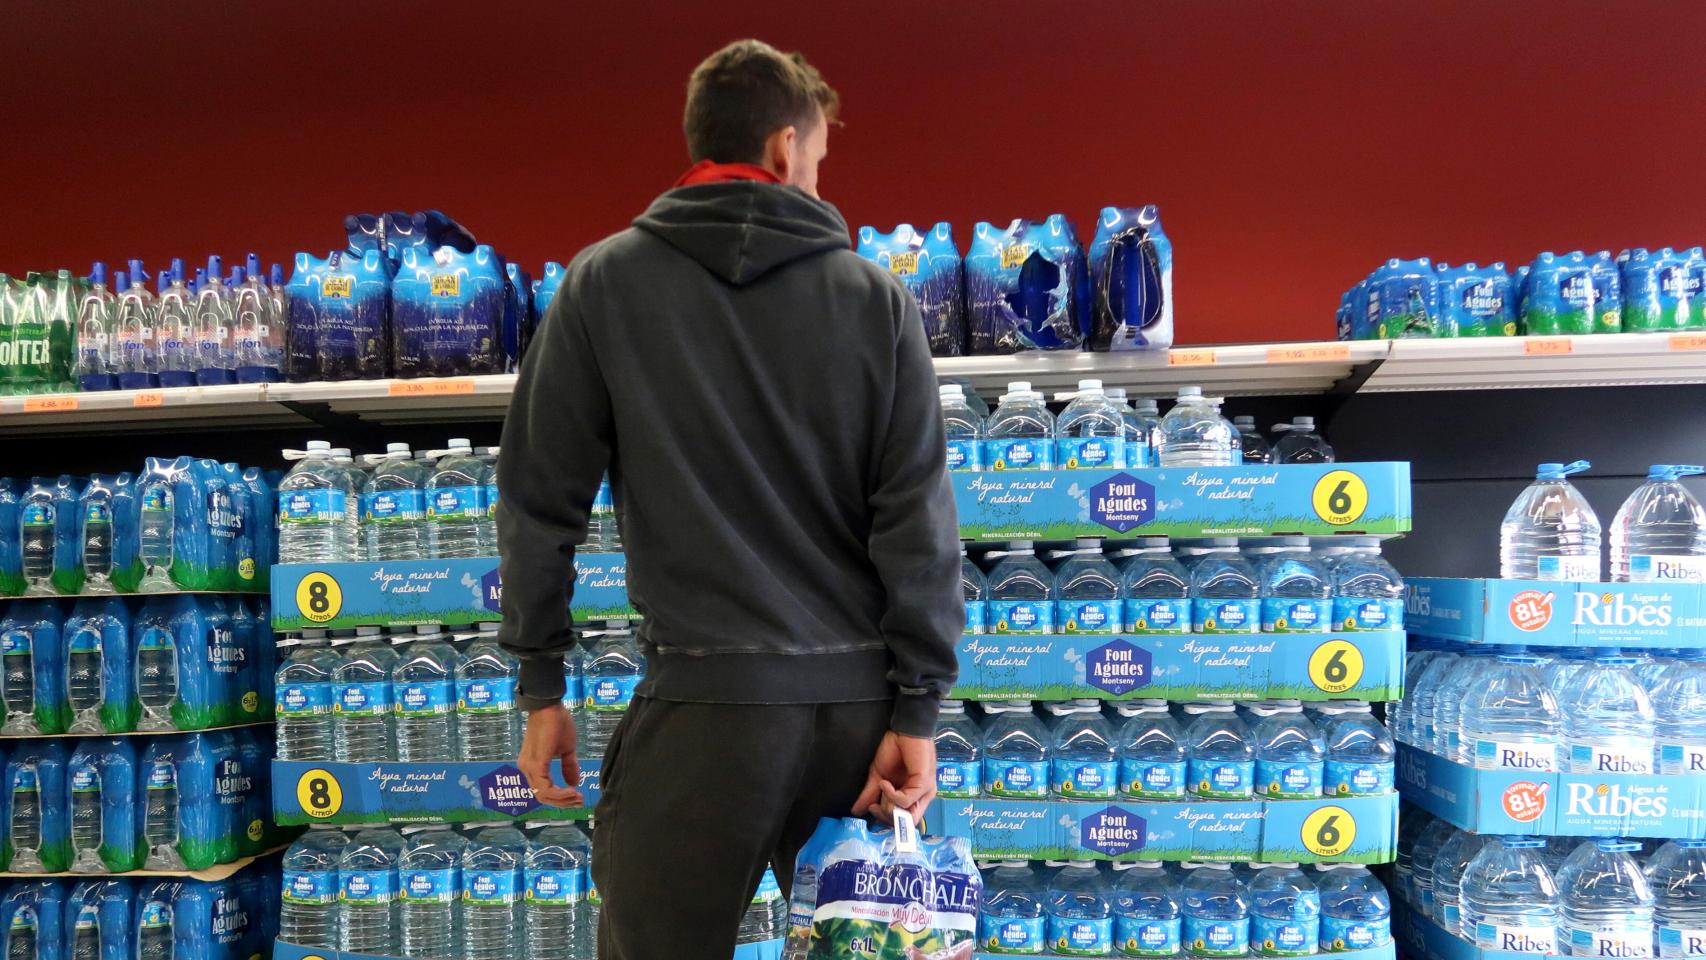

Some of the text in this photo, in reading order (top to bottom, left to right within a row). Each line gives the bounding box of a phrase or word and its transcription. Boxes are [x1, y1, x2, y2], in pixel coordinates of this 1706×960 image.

[1465, 297, 1502, 309] Agudes
[967, 475, 1056, 501] Agua mineral
[1108, 482, 1136, 497] Font
[1182, 471, 1279, 496] Aigua mineral
[991, 490, 1034, 503] natural
[1208, 487, 1255, 500] natural
[1328, 480, 1352, 515] 6
[1098, 497, 1148, 514] Agudes
[1106, 513, 1139, 522] Montseny
[370, 567, 450, 592] Agua mineral
[590, 574, 626, 588] natura
[392, 582, 432, 594] natural
[309, 581, 329, 613] 8
[1631, 592, 1673, 605] Aigua de
[1570, 591, 1672, 627] Ribes
[310, 613, 332, 621] LITROS
[963, 639, 1052, 663] Agua mineral
[1105, 648, 1132, 661] Font
[1179, 640, 1276, 663] Aigua mineral
[986, 655, 1031, 666] natural
[1204, 654, 1251, 667] natural
[1324, 649, 1347, 684] 6
[1094, 662, 1144, 677] Agudes
[1102, 677, 1135, 686] Montseny
[1323, 683, 1346, 691] LITRES
[1501, 748, 1551, 769] Ribes
[1598, 753, 1647, 773] Ribes
[368, 767, 447, 790] Agua mineral
[495, 774, 521, 787] Font
[309, 777, 331, 809] 8
[391, 782, 430, 793] natural
[488, 787, 534, 801] Agudes
[1627, 784, 1669, 796] Aigua de
[1564, 782, 1668, 818] Ribes
[958, 803, 1048, 825] Agua mineral
[1100, 814, 1127, 827] Font
[1174, 808, 1270, 829] Aigua mineral
[981, 819, 1025, 831] natural
[1199, 821, 1246, 832] natural
[1316, 815, 1340, 848] 6
[1089, 827, 1139, 841] Agudes
[1097, 840, 1131, 849] Montseny
[1315, 847, 1338, 855] LITRES
[854, 872, 978, 910] BRONCHALES
[890, 907, 910, 926] Muy
[850, 937, 877, 954] 6x1L
[1502, 932, 1551, 952] Ribes
[1599, 939, 1647, 958] Ribes
